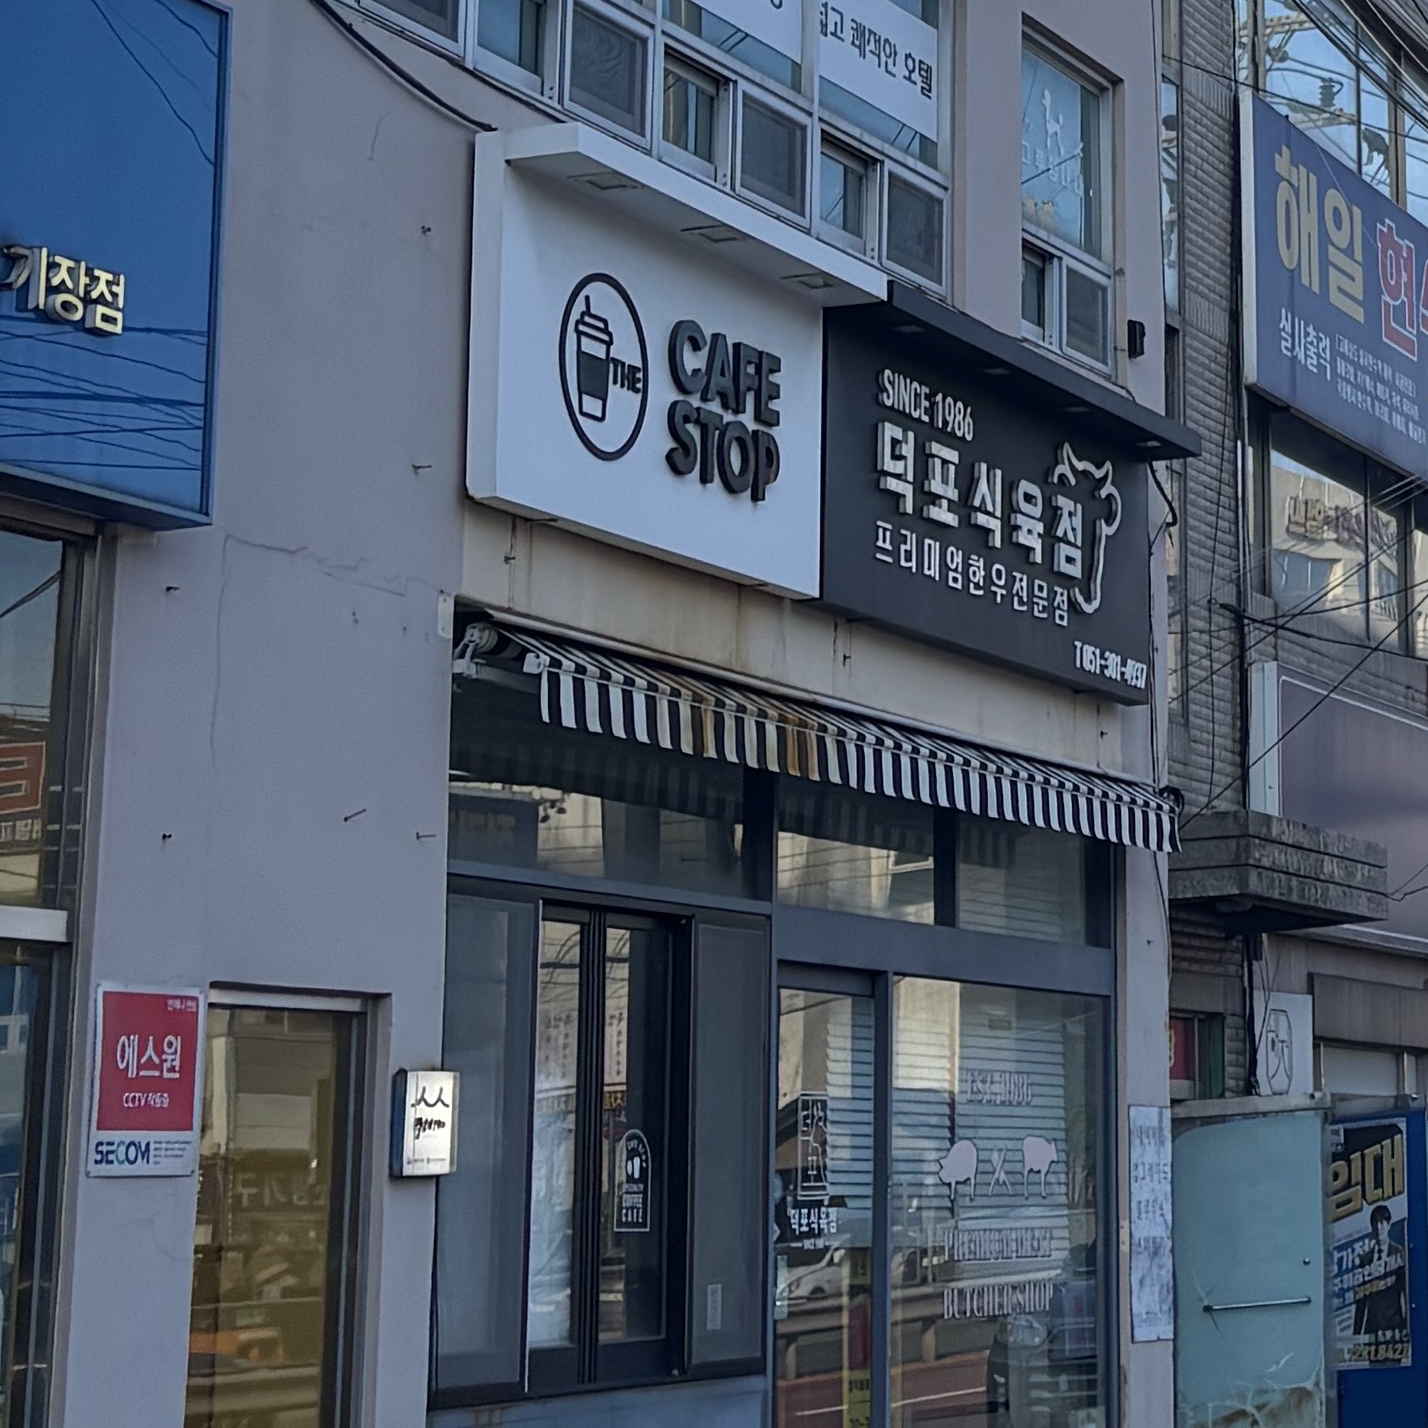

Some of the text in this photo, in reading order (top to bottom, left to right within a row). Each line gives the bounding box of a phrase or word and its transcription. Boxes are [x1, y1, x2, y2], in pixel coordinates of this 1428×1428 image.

[1275, 143, 1366, 325] 해일
[3, 243, 126, 336] 기장점
[610, 356, 642, 395] THE
[668, 319, 781, 427] CAFE
[1279, 307, 1331, 382] 실사출력
[878, 368, 974, 442] SINCE 1986
[665, 399, 781, 502] STOP
[877, 421, 1083, 580] 덕포식육점
[875, 520, 1069, 627] 프리미엄한우전문점
[116, 1034, 182, 1079] 에스원
[123, 1092, 146, 1108] CCTV
[94, 1140, 150, 1166] SECOM
[1329, 1133, 1405, 1223] 임대
